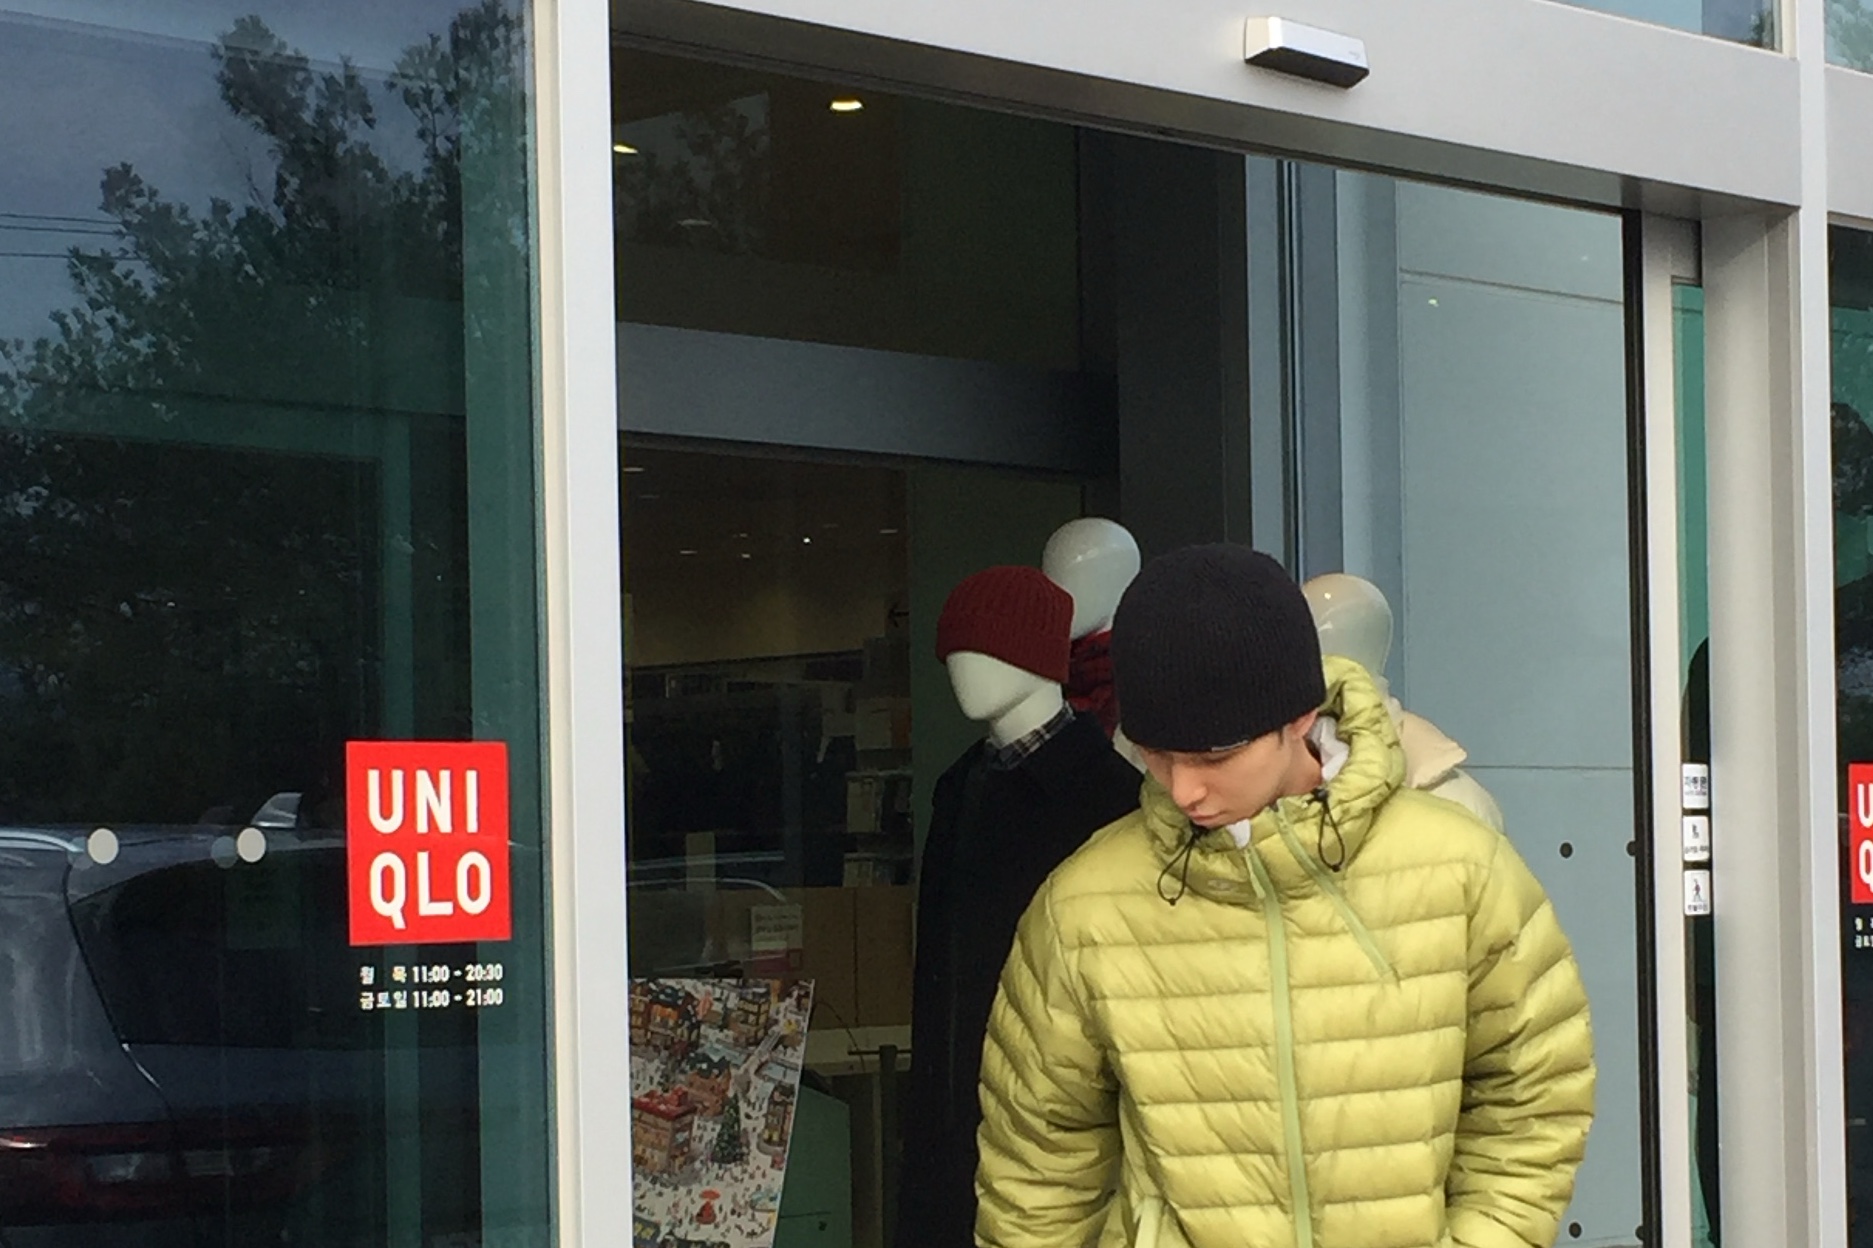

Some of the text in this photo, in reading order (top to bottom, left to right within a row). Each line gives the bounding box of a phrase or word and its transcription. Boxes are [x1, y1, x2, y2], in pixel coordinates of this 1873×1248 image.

[367, 769, 479, 834] UNI
[369, 851, 492, 930] QLO
[412, 965, 450, 983] 11:00
[412, 989, 450, 1008] 11:00
[465, 988, 504, 1006] 21:00
